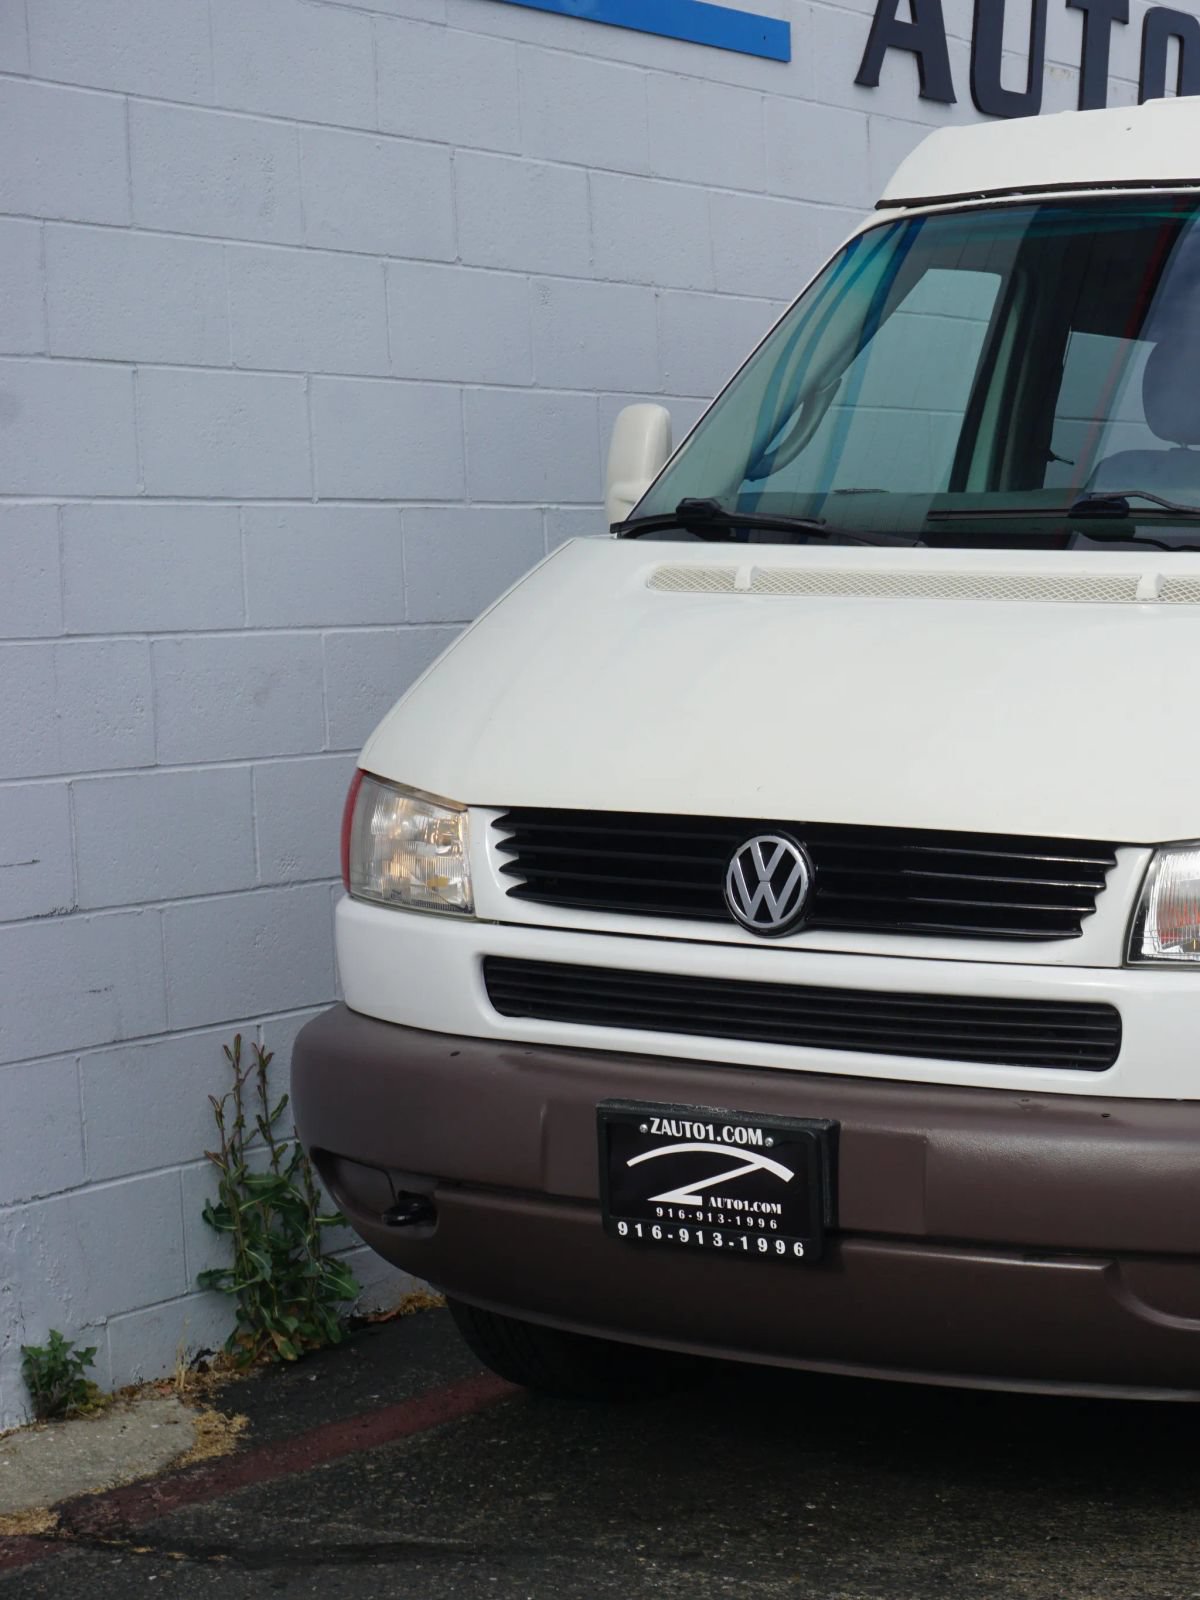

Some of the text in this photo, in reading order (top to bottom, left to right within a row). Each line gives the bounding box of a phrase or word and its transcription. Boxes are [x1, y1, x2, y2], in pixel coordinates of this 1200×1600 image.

[649, 1117, 763, 1146] ZAUTO1.COM
[708, 1196, 782, 1215] AUTO1.COM
[616, 1221, 805, 1257] 916-913-1996
